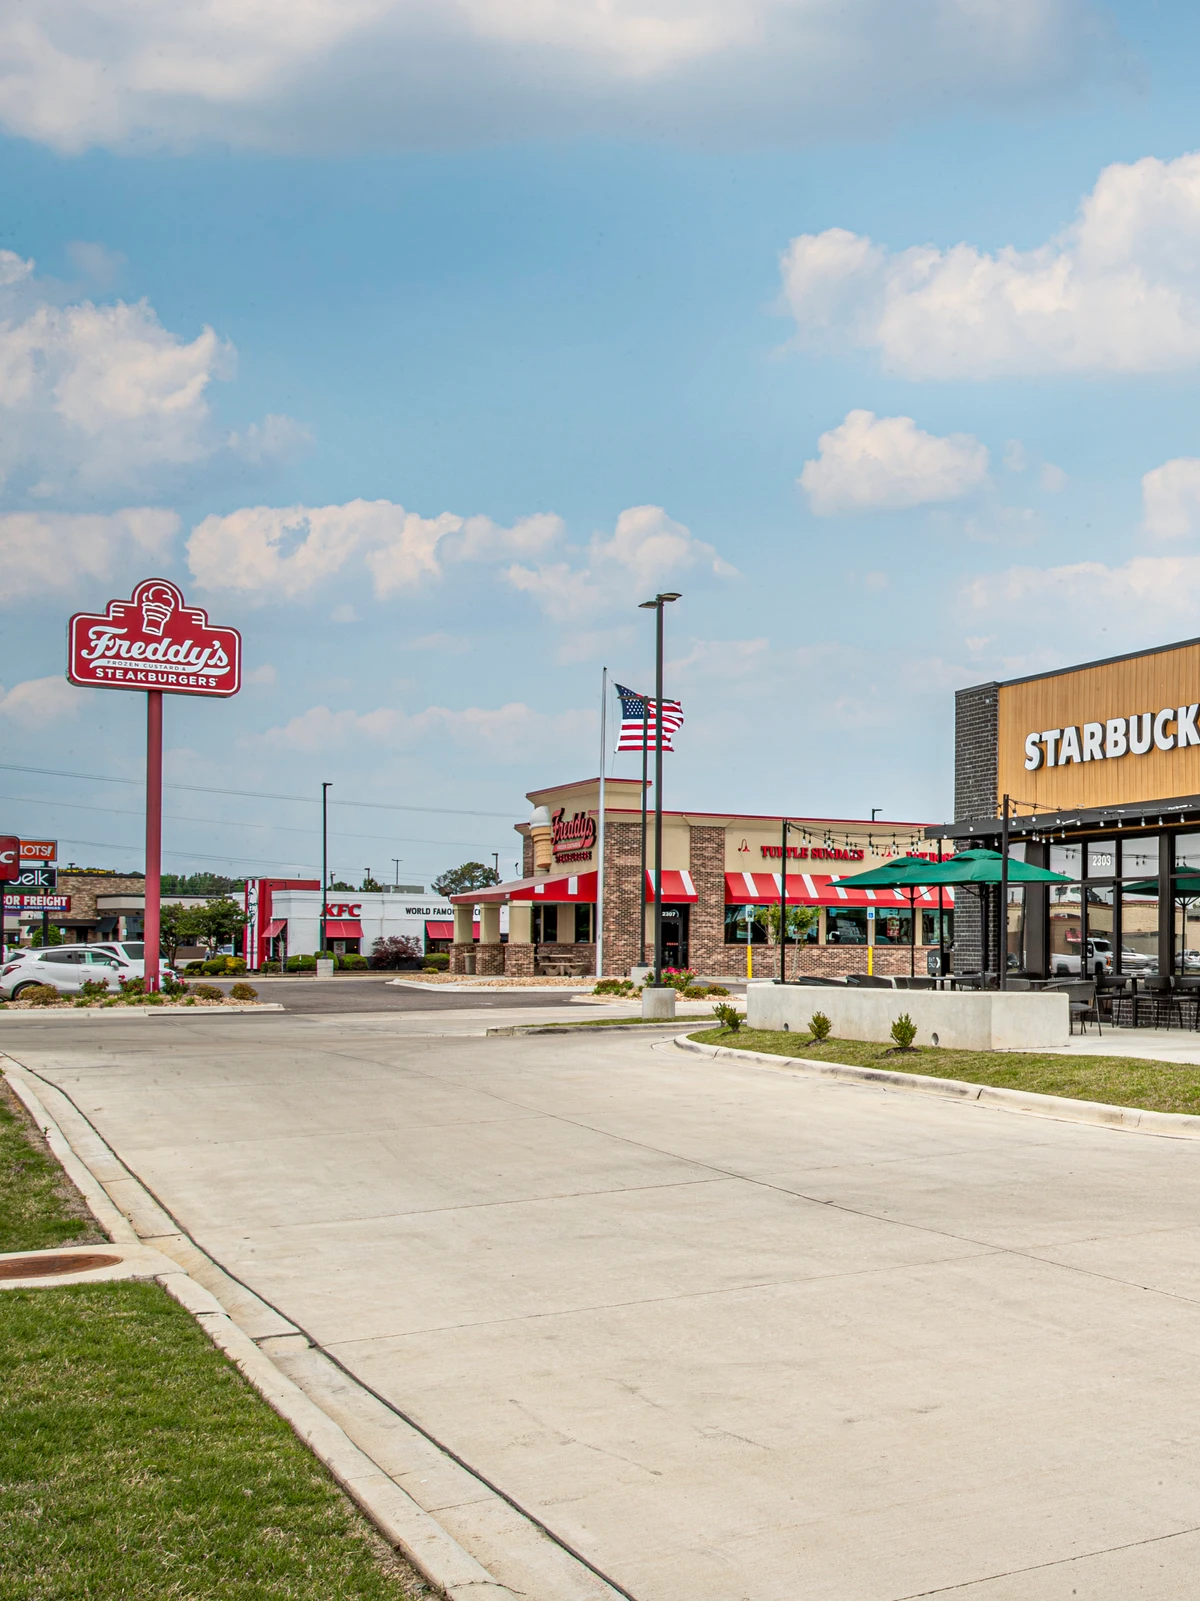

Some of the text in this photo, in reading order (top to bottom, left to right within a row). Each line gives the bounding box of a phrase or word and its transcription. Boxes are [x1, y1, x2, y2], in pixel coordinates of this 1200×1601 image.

[81, 625, 231, 675] Freddy's
[107, 660, 139, 668] FROZEN
[143, 663, 180, 671] CUSTARD
[96, 668, 216, 687] STEAKBURGERS
[20, 845, 53, 856] LOTS!
[1092, 855, 1112, 867] 2303
[24, 896, 67, 906] FREIGHT
[319, 903, 362, 918] KFC
[405, 907, 431, 915] WORLD
